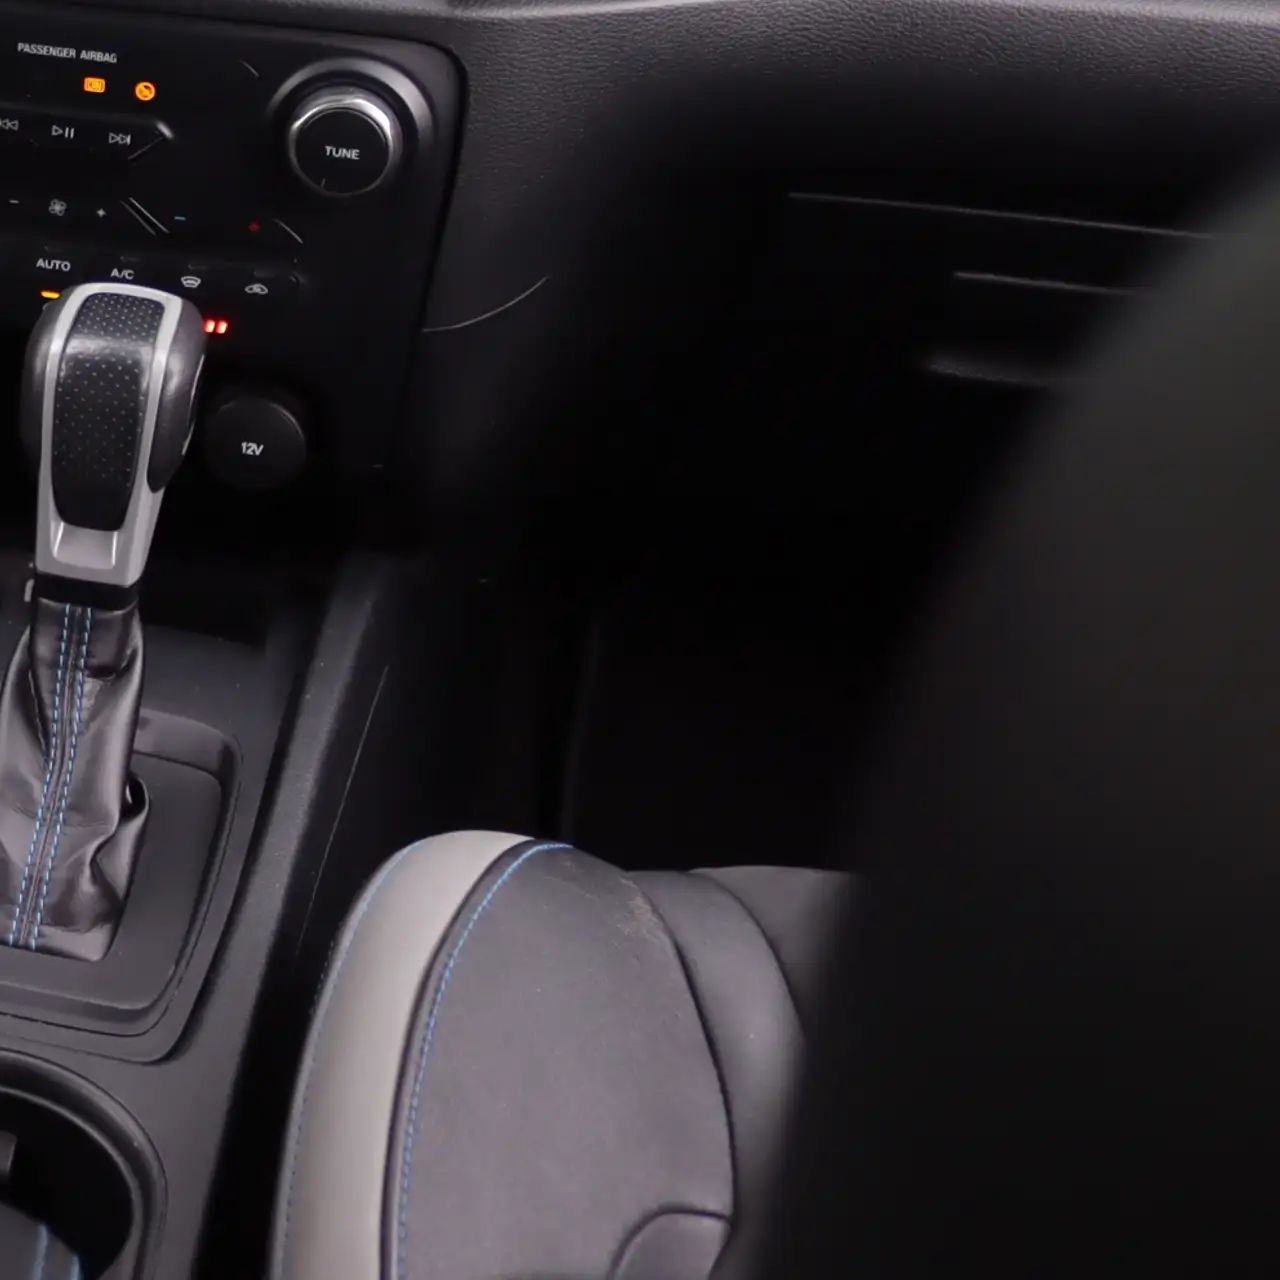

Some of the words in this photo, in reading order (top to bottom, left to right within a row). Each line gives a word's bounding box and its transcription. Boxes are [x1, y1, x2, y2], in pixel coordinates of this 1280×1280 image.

[17, 42, 77, 59] PASSENGER
[80, 49, 118, 64] AIRBAG
[324, 145, 360, 161] TUNE
[36, 257, 71, 272] AUTO
[110, 267, 135, 280] A/C
[240, 440, 264, 457] 12V
